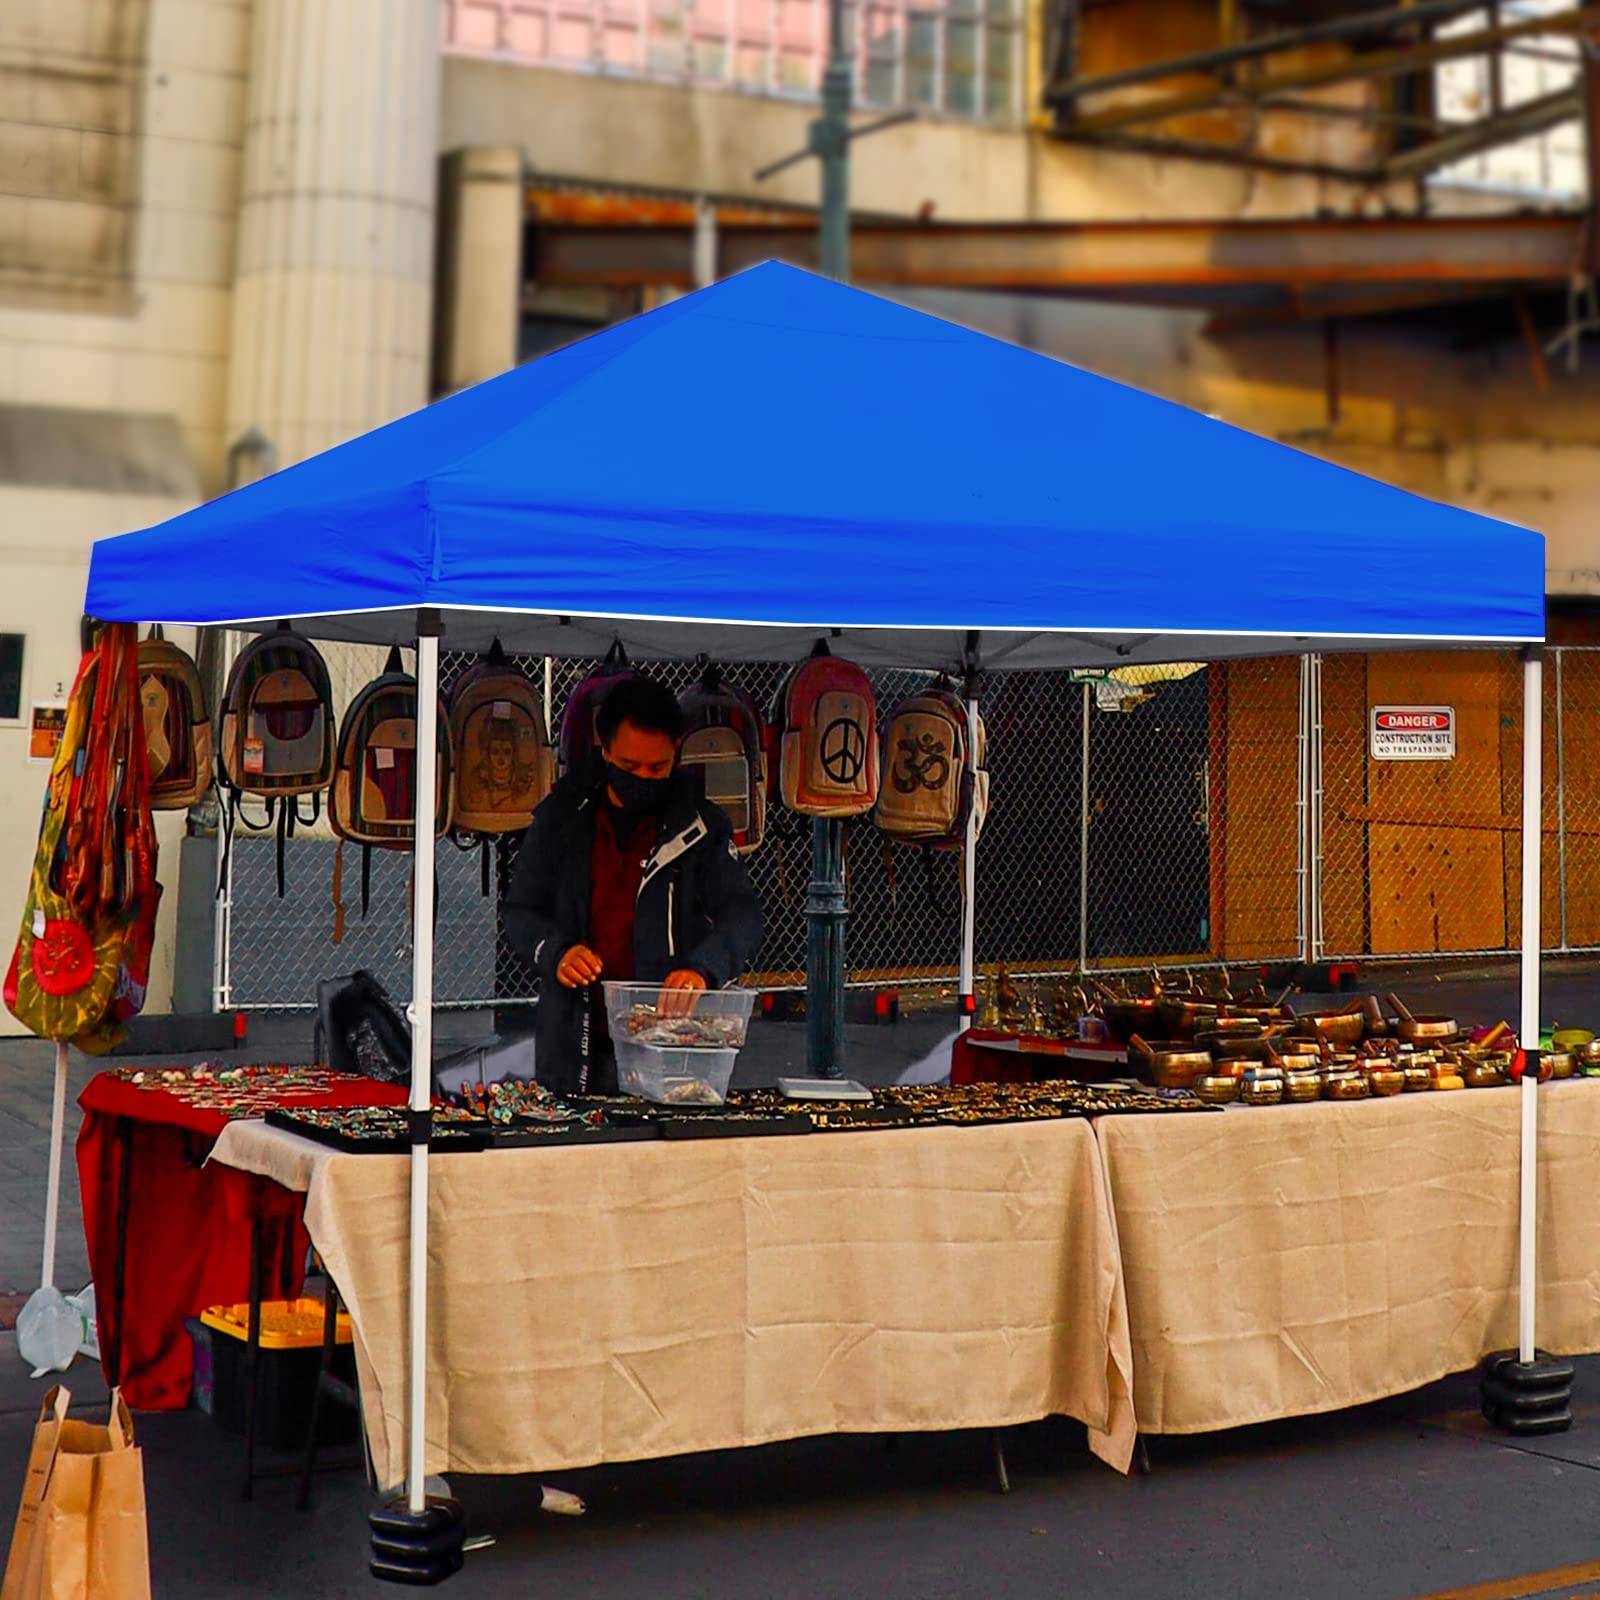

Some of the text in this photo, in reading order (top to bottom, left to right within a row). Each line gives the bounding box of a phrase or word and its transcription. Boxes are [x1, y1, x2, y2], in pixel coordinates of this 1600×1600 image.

[1389, 716, 1437, 727] DANGER
[1375, 734, 1451, 744] CONSTRUCTION SITE
